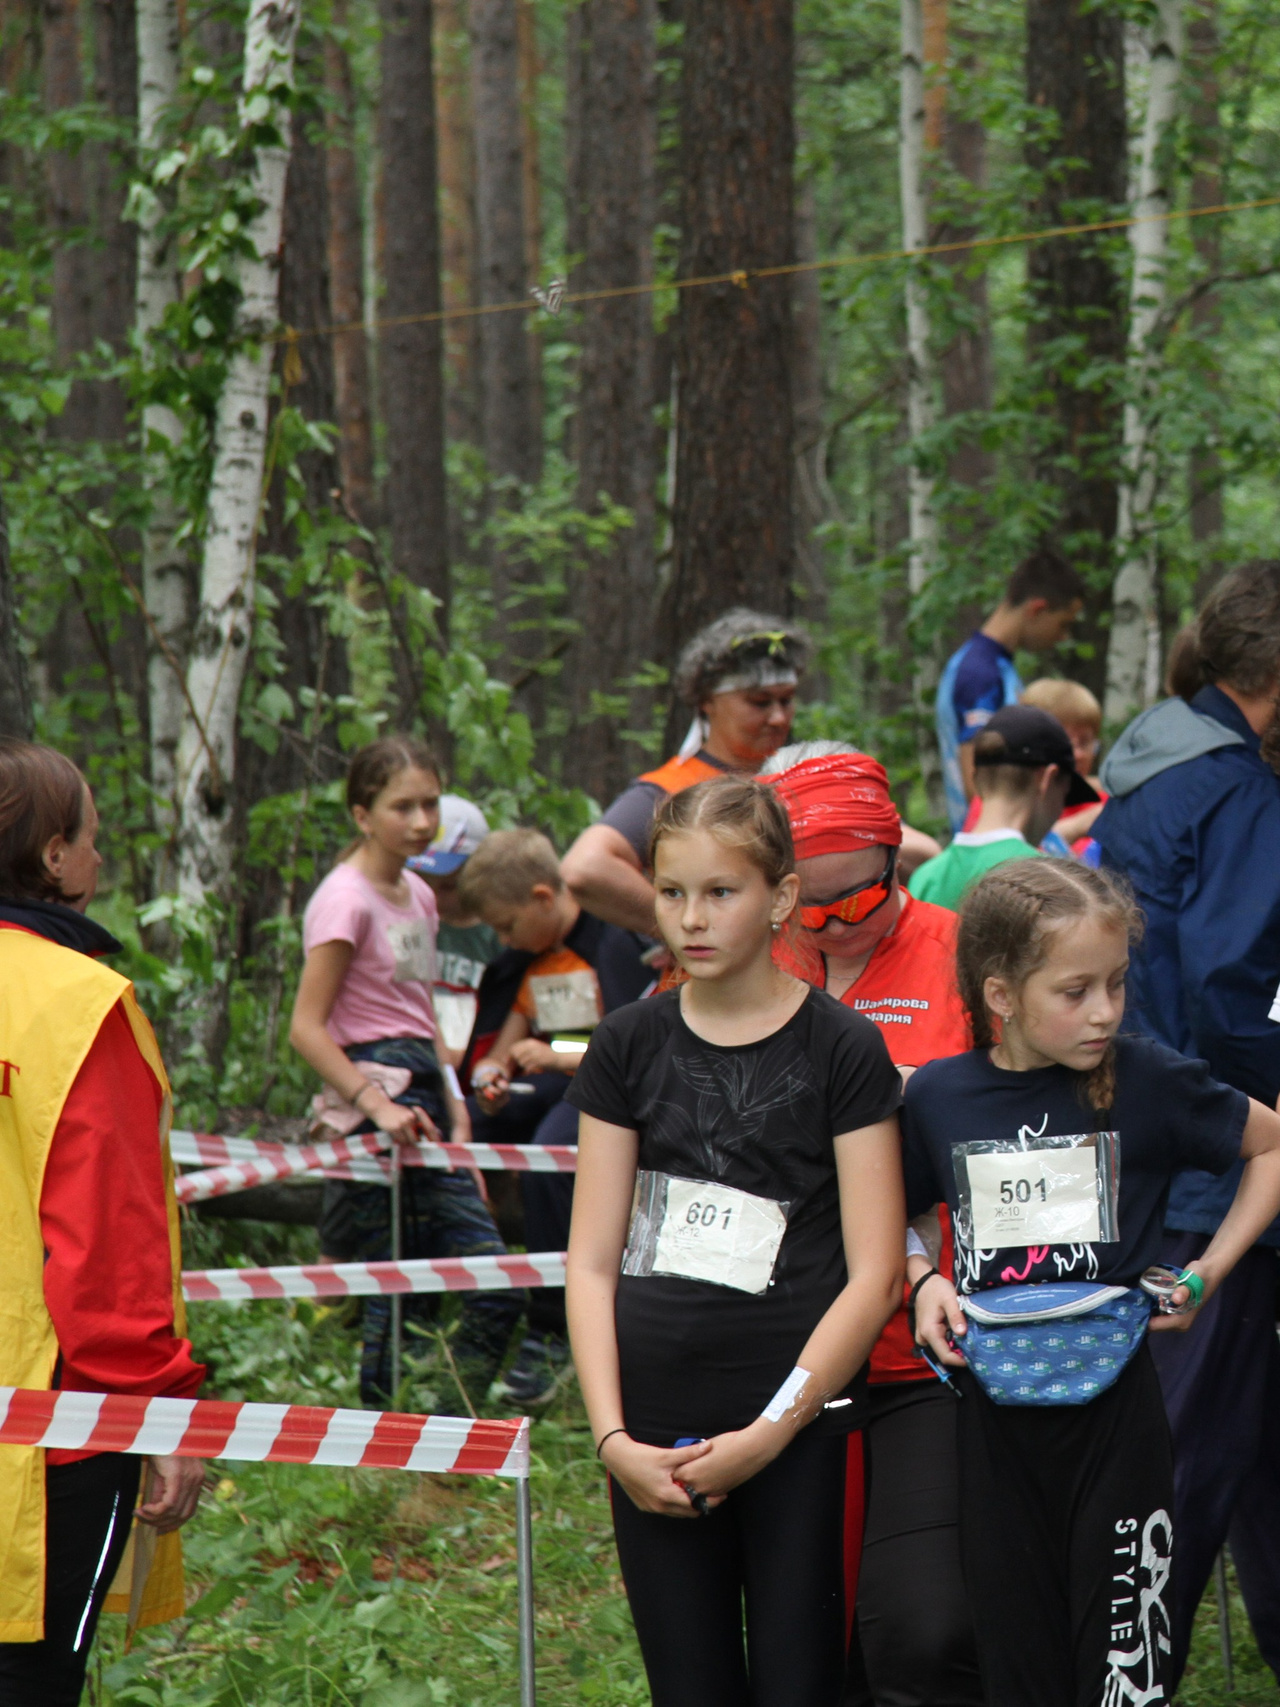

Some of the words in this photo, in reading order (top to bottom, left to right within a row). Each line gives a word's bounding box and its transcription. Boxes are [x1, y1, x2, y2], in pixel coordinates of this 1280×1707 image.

[854, 997, 929, 1010] Шакирова
[1000, 1178, 1047, 1204] 501
[685, 1201, 733, 1231] 601
[995, 1206, 1020, 1217] Ж-10
[1111, 1518, 1137, 1641] STYLE
